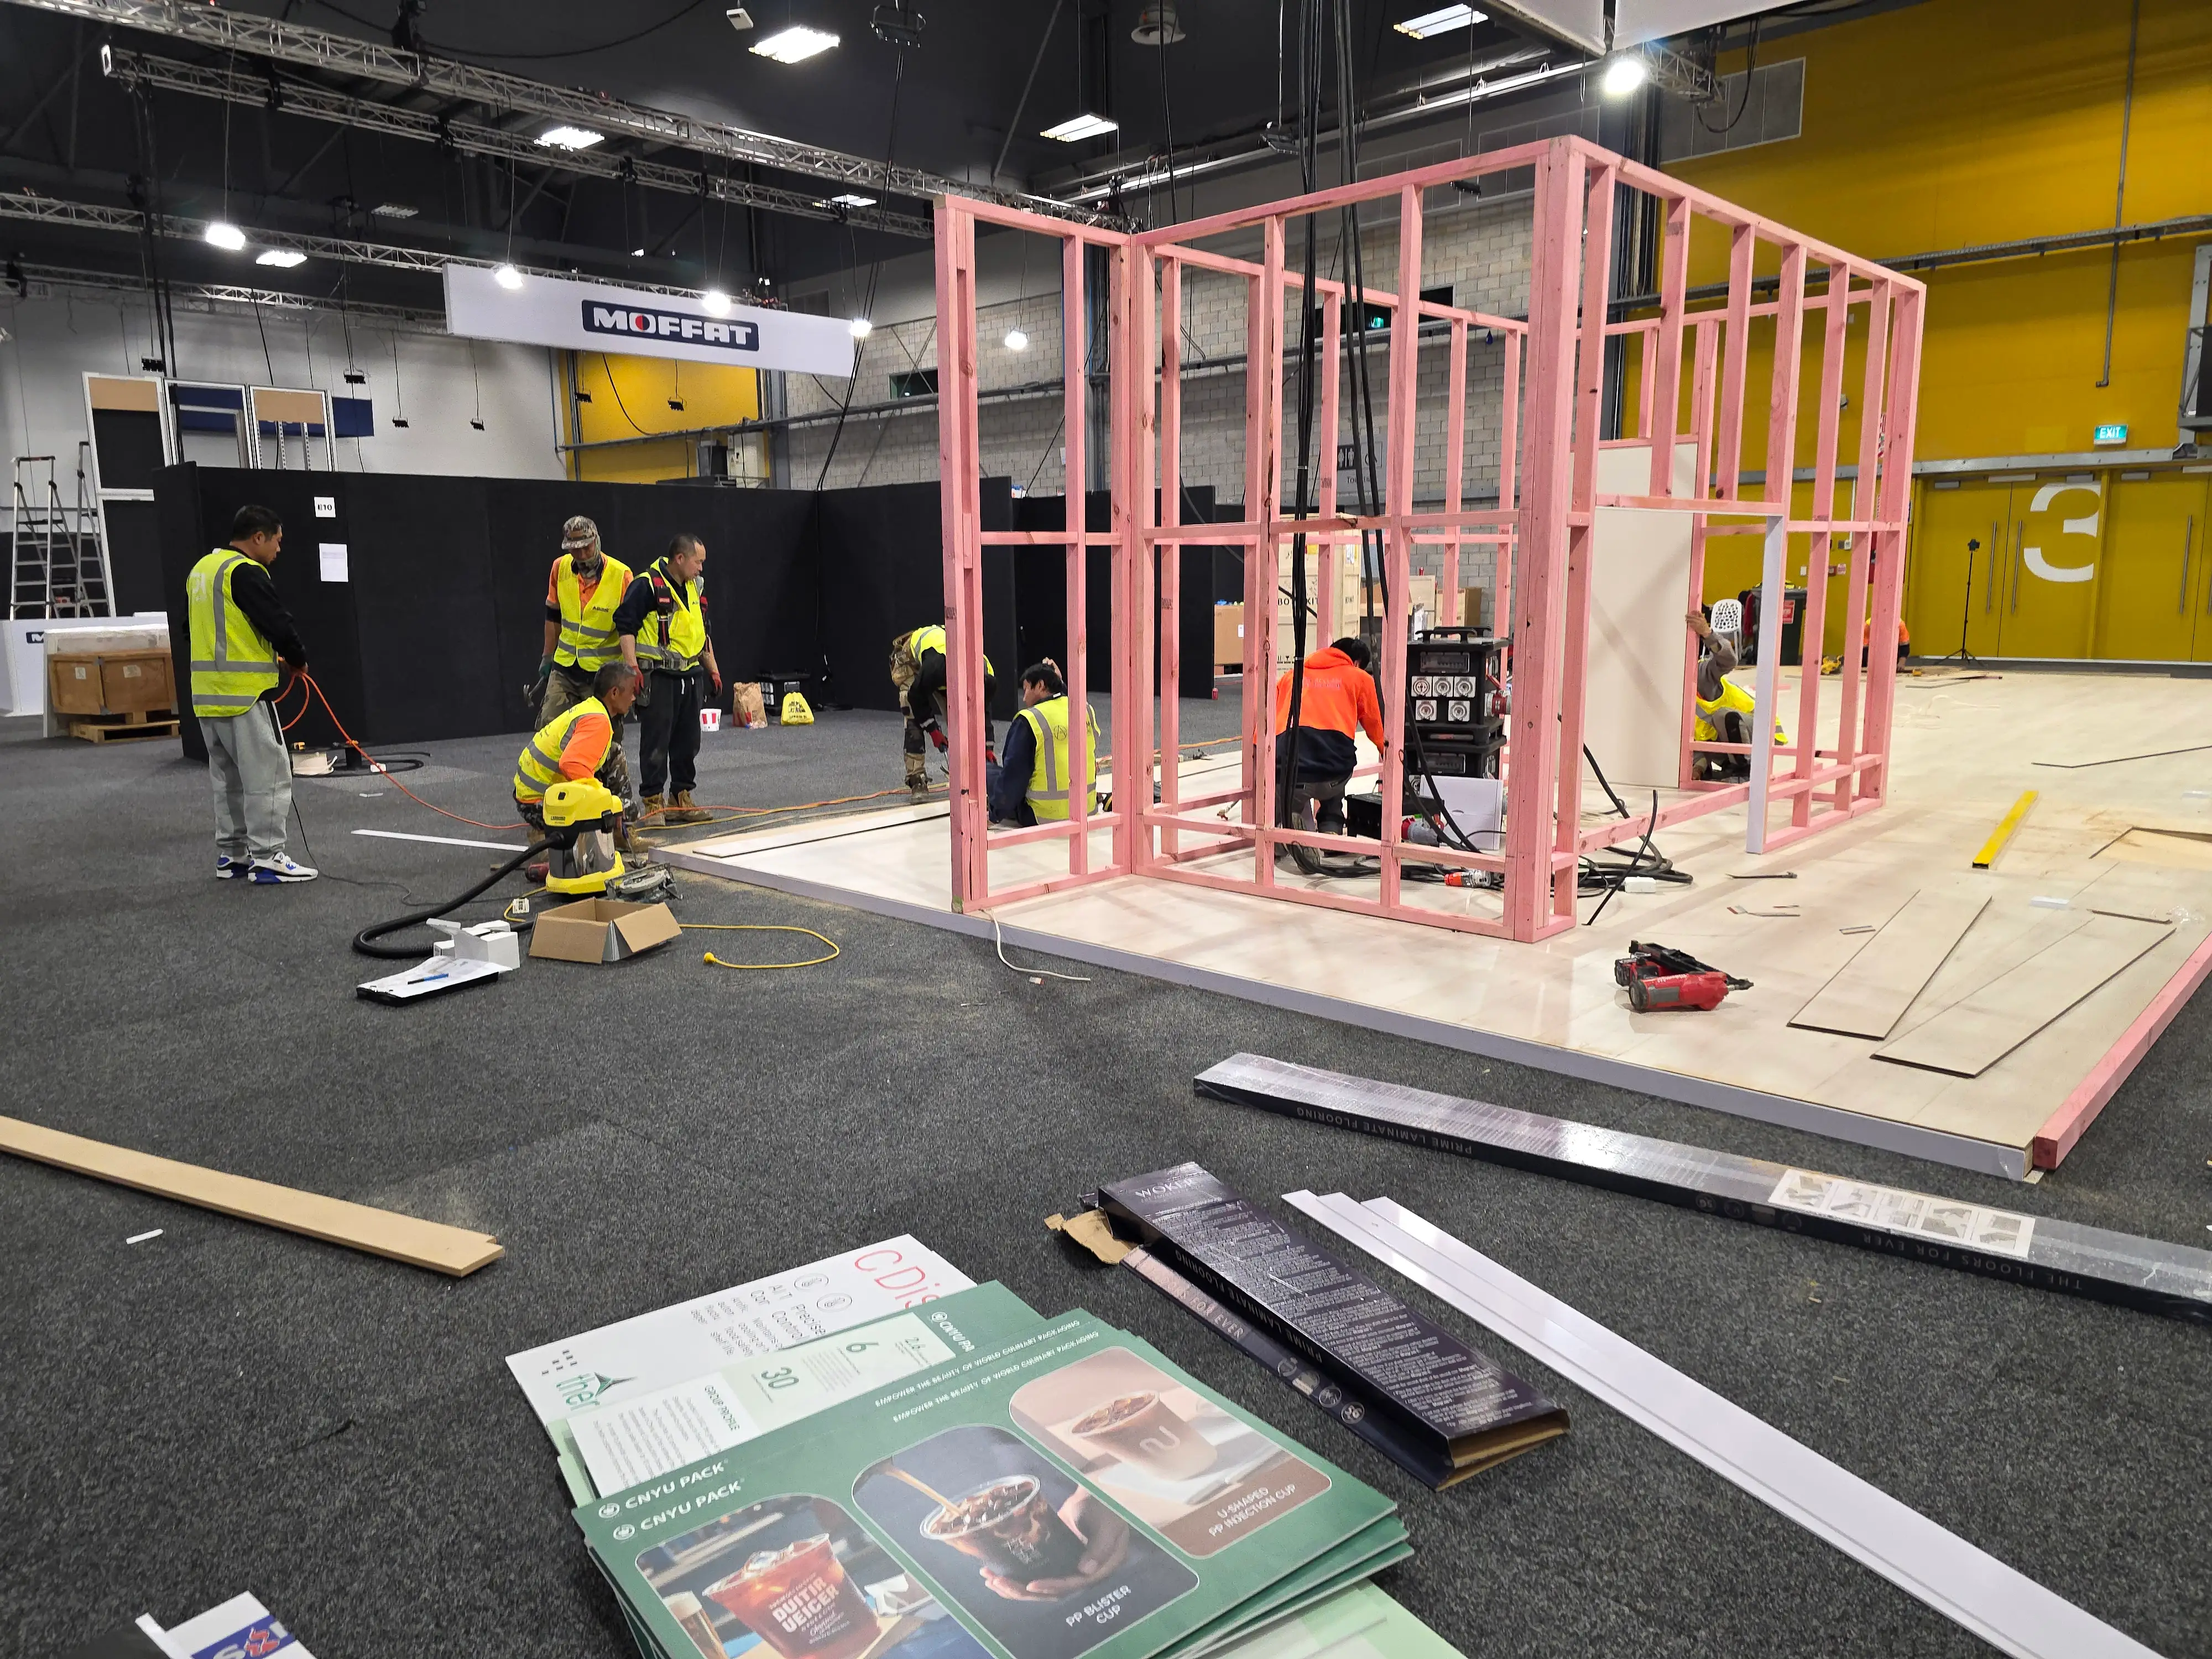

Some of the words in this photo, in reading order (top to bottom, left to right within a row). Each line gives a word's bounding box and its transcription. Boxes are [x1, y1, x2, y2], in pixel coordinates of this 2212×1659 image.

[593, 307, 752, 345] MOFFAT
[2099, 426, 2121, 439] EXIT
[2024, 481, 2101, 582] 3
[1297, 1107, 1358, 1129] FLOORING
[1363, 1121, 1426, 1144] LAMINATE
[1432, 1140, 1472, 1155] PRIME
[1863, 1233, 1905, 1250] EVER
[1916, 1244, 1950, 1261] FOR
[1961, 1252, 2034, 1280] FLOORS
[2048, 1272, 2083, 1290] THE
[772, 1311, 810, 1343] Control
[791, 1303, 826, 1336] Precise
[1190, 1297, 1217, 1317] FOR
[1214, 1314, 1244, 1339] EVER
[846, 1341, 880, 1353] 6
[1285, 1328, 1322, 1363] PRIME
[761, 1366, 800, 1390] 30
[875, 1386, 915, 1407] EMPOWER
[917, 1380, 932, 1391] THE
[962, 1363, 973, 1371] OF
[974, 1352, 1001, 1366] WORLD
[893, 1401, 934, 1423] EMPOWER
[935, 1394, 951, 1405] THE
[993, 1365, 1020, 1380] WORLD
[705, 1385, 724, 1406] GROUP
[625, 1481, 675, 1509] CNYU
[680, 1462, 724, 1488] PACK
[640, 1501, 692, 1531] CNYU
[696, 1480, 742, 1508] PACK
[1208, 1524, 1223, 1537] PP
[1223, 1495, 1277, 1528] INJECTION
[1275, 1483, 1296, 1500] CUP
[1217, 1487, 1269, 1519] U-SHAPED
[1066, 1611, 1082, 1627] PP
[1083, 1585, 1131, 1617] BLISTER
[1096, 1604, 1120, 1624] CUP
